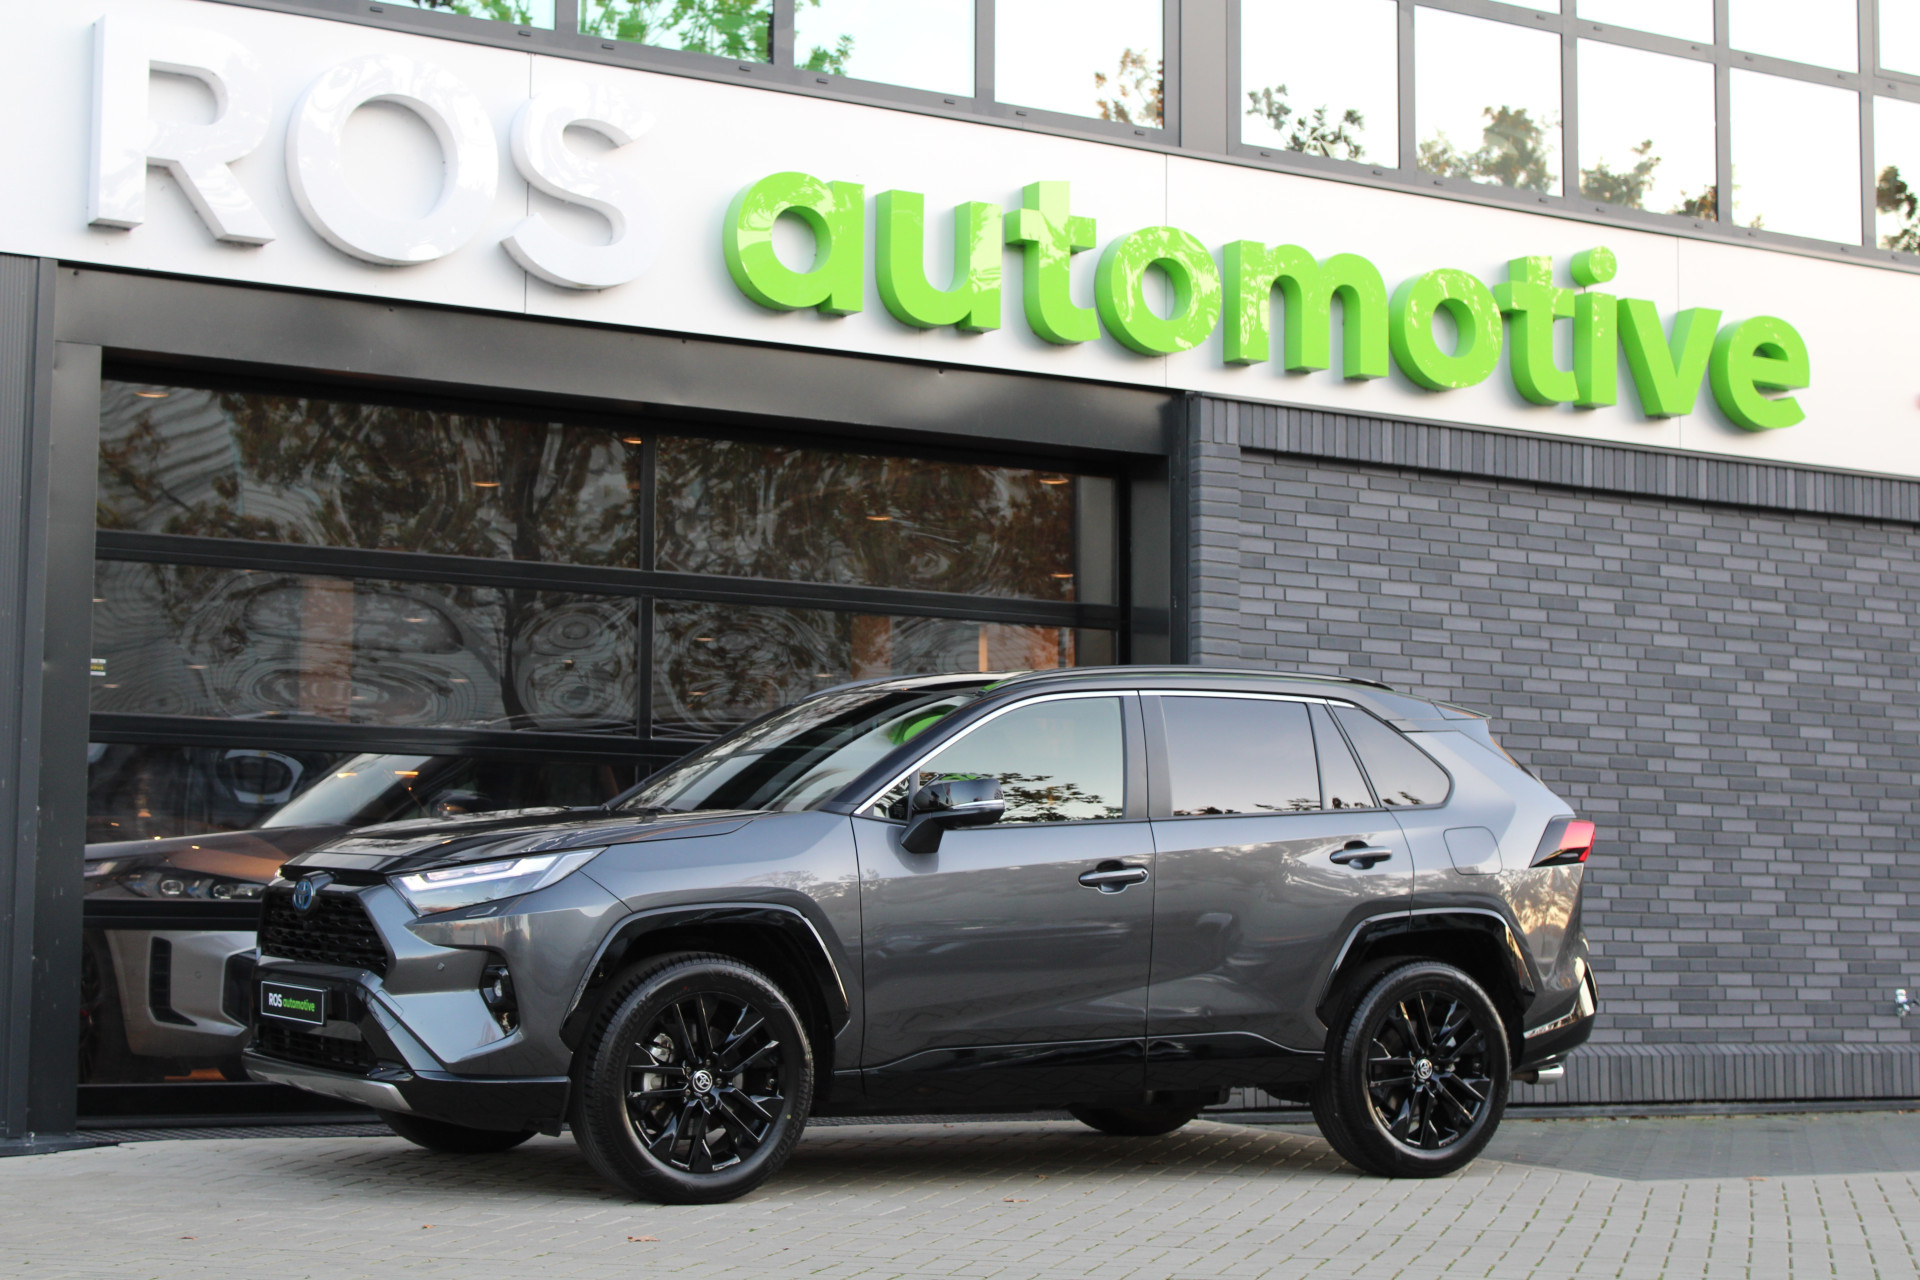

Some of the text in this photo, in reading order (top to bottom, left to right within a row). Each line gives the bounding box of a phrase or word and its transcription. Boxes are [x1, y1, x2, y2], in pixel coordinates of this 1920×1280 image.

[88, 14, 1810, 432] ROS automotive
[268, 992, 316, 1012] ROS automotive
